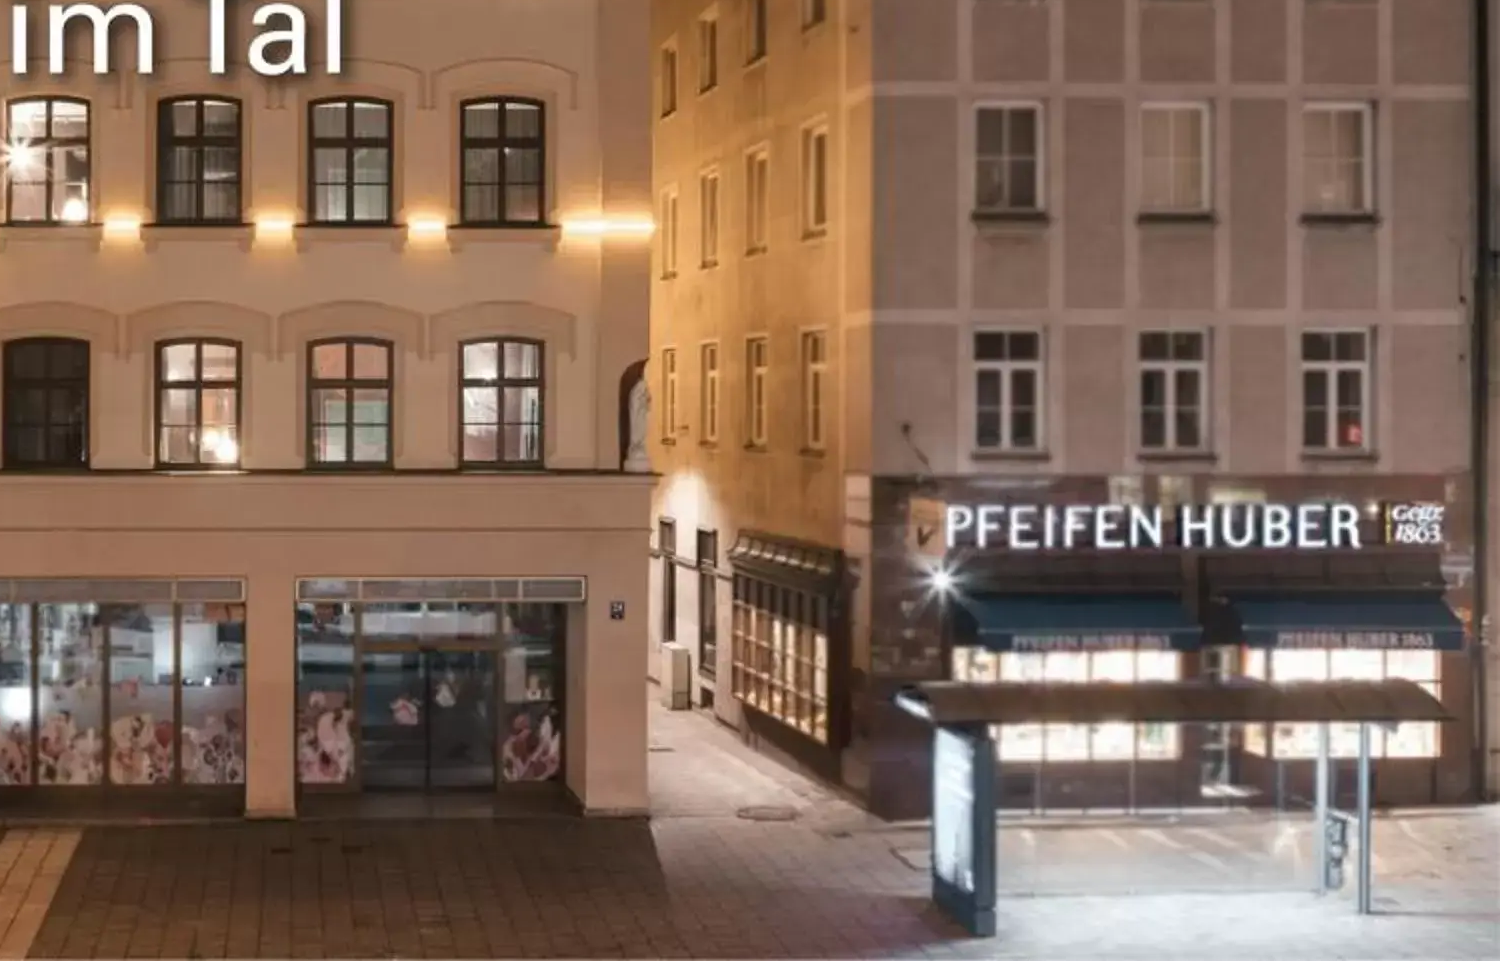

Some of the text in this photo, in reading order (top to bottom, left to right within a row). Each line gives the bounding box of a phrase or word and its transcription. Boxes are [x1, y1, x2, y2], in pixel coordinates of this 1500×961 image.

[946, 504, 1361, 549] PFEIFEN HUBER
[1394, 523, 1442, 544] 1863
